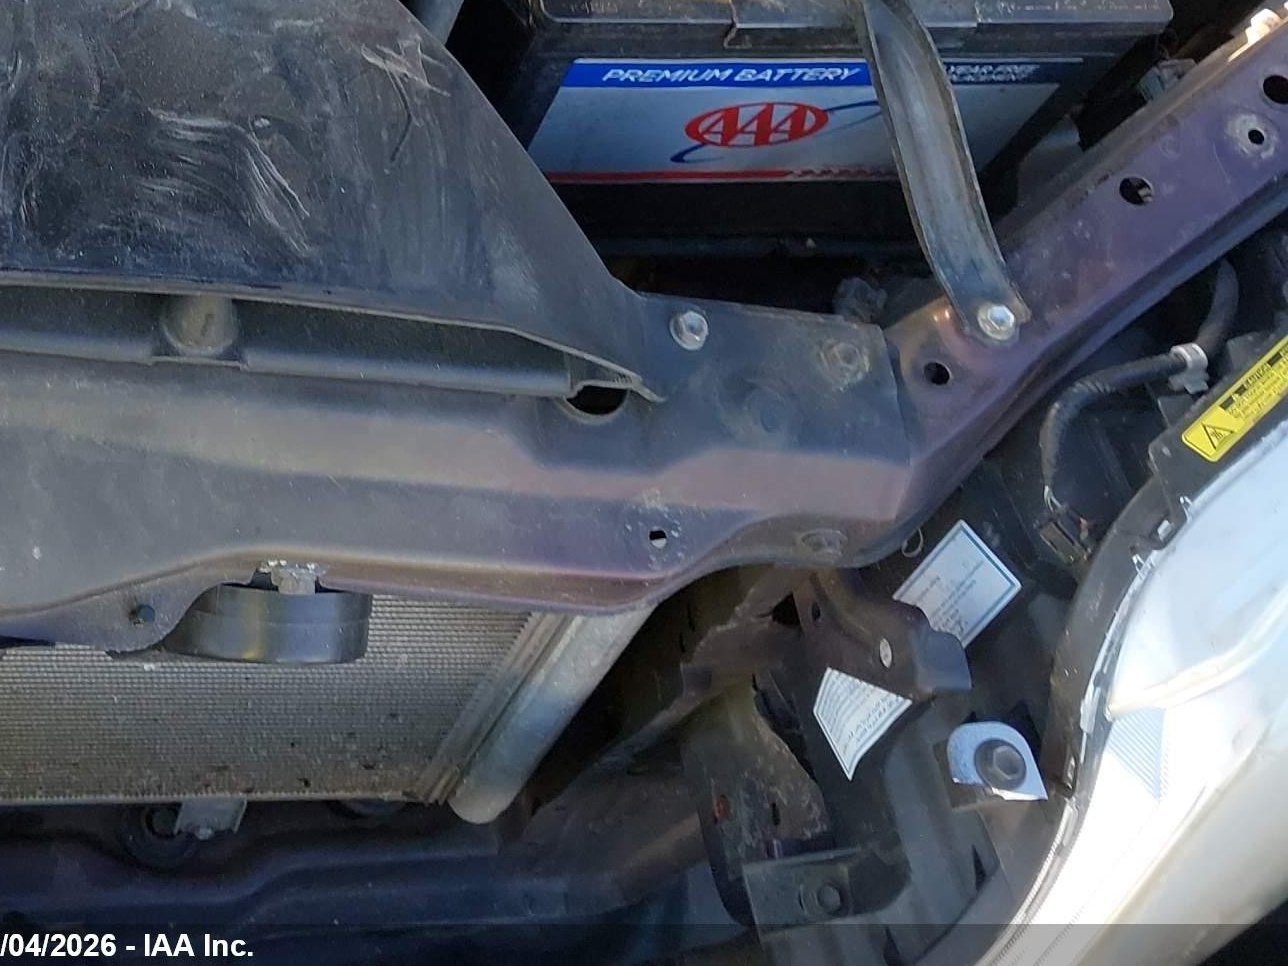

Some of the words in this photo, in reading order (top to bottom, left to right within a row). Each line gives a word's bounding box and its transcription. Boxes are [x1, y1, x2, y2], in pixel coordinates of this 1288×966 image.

[602, 67, 734, 83] PREMIUM
[734, 67, 861, 82] BATTERY
[696, 103, 817, 147] AAA
